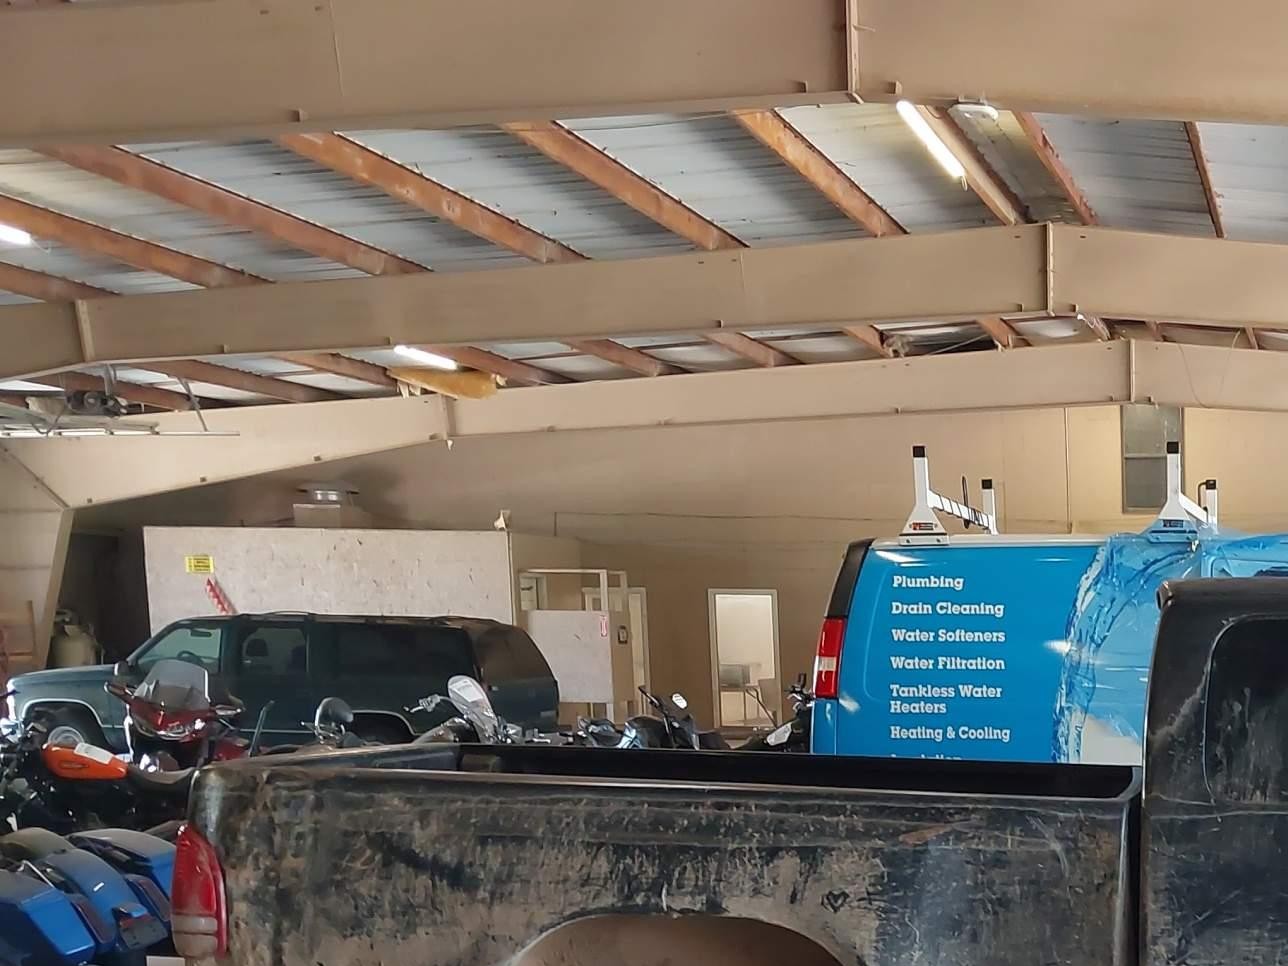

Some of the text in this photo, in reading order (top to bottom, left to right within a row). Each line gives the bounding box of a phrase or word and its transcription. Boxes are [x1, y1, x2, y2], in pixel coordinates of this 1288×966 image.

[893, 575, 964, 591] Plumbing
[891, 601, 1005, 617] Drain Cleaning
[892, 629, 1006, 643] Water Softeners
[891, 656, 1006, 671] Water Filtration
[890, 684, 1002, 699] Tankless Water
[890, 702, 947, 715] Heaters
[890, 726, 1011, 742] Heating & Cooling
